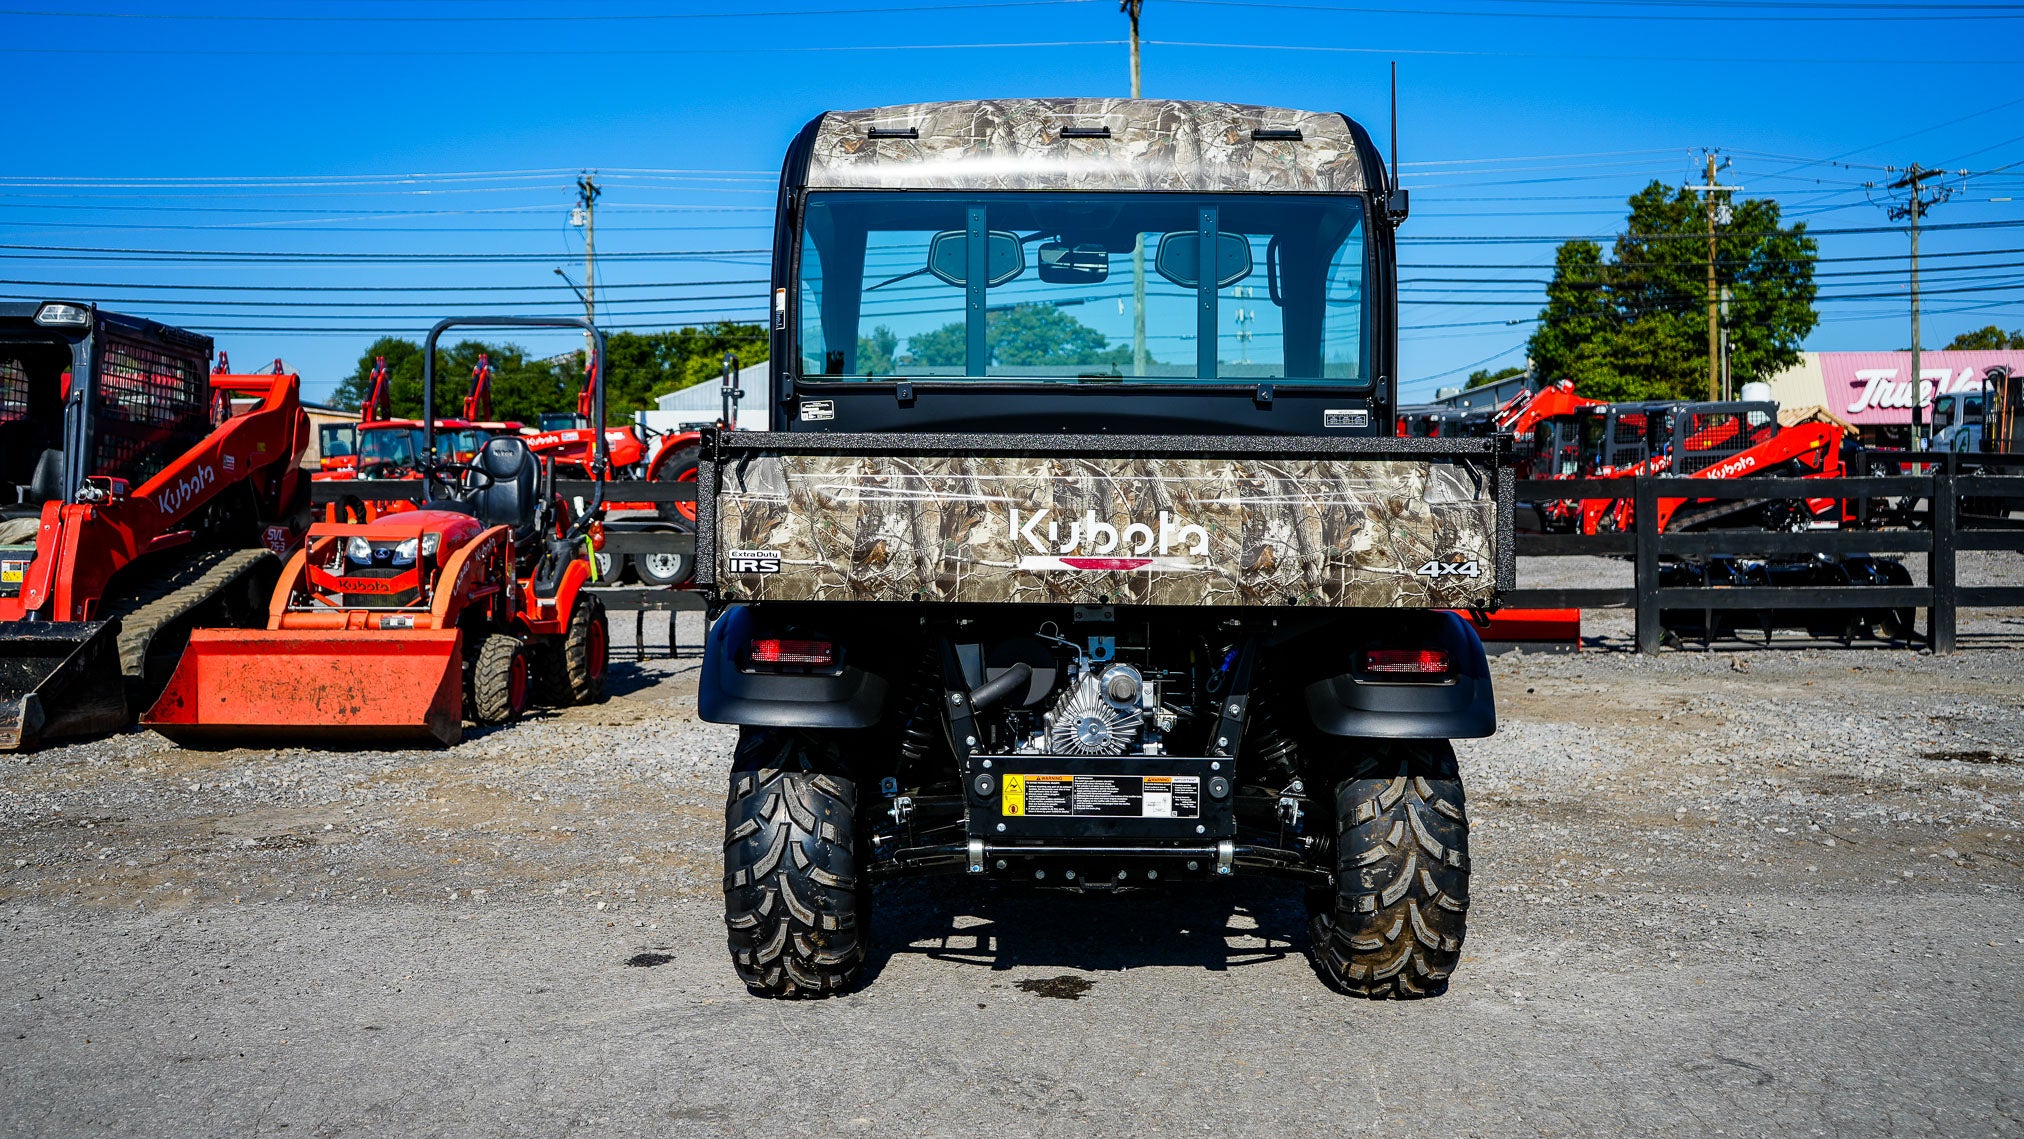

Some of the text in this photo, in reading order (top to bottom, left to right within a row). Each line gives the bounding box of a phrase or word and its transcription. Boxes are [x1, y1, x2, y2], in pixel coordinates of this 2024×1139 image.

[1847, 368, 1934, 413] True
[1706, 456, 1755, 479] Kubota
[158, 464, 215, 514] Kubota
[267, 529, 285, 541] SVL
[1009, 508, 1209, 556] Kubota
[730, 559, 779, 572] IRS
[1416, 560, 1481, 578] 4x4
[339, 580, 390, 592] Kubota
